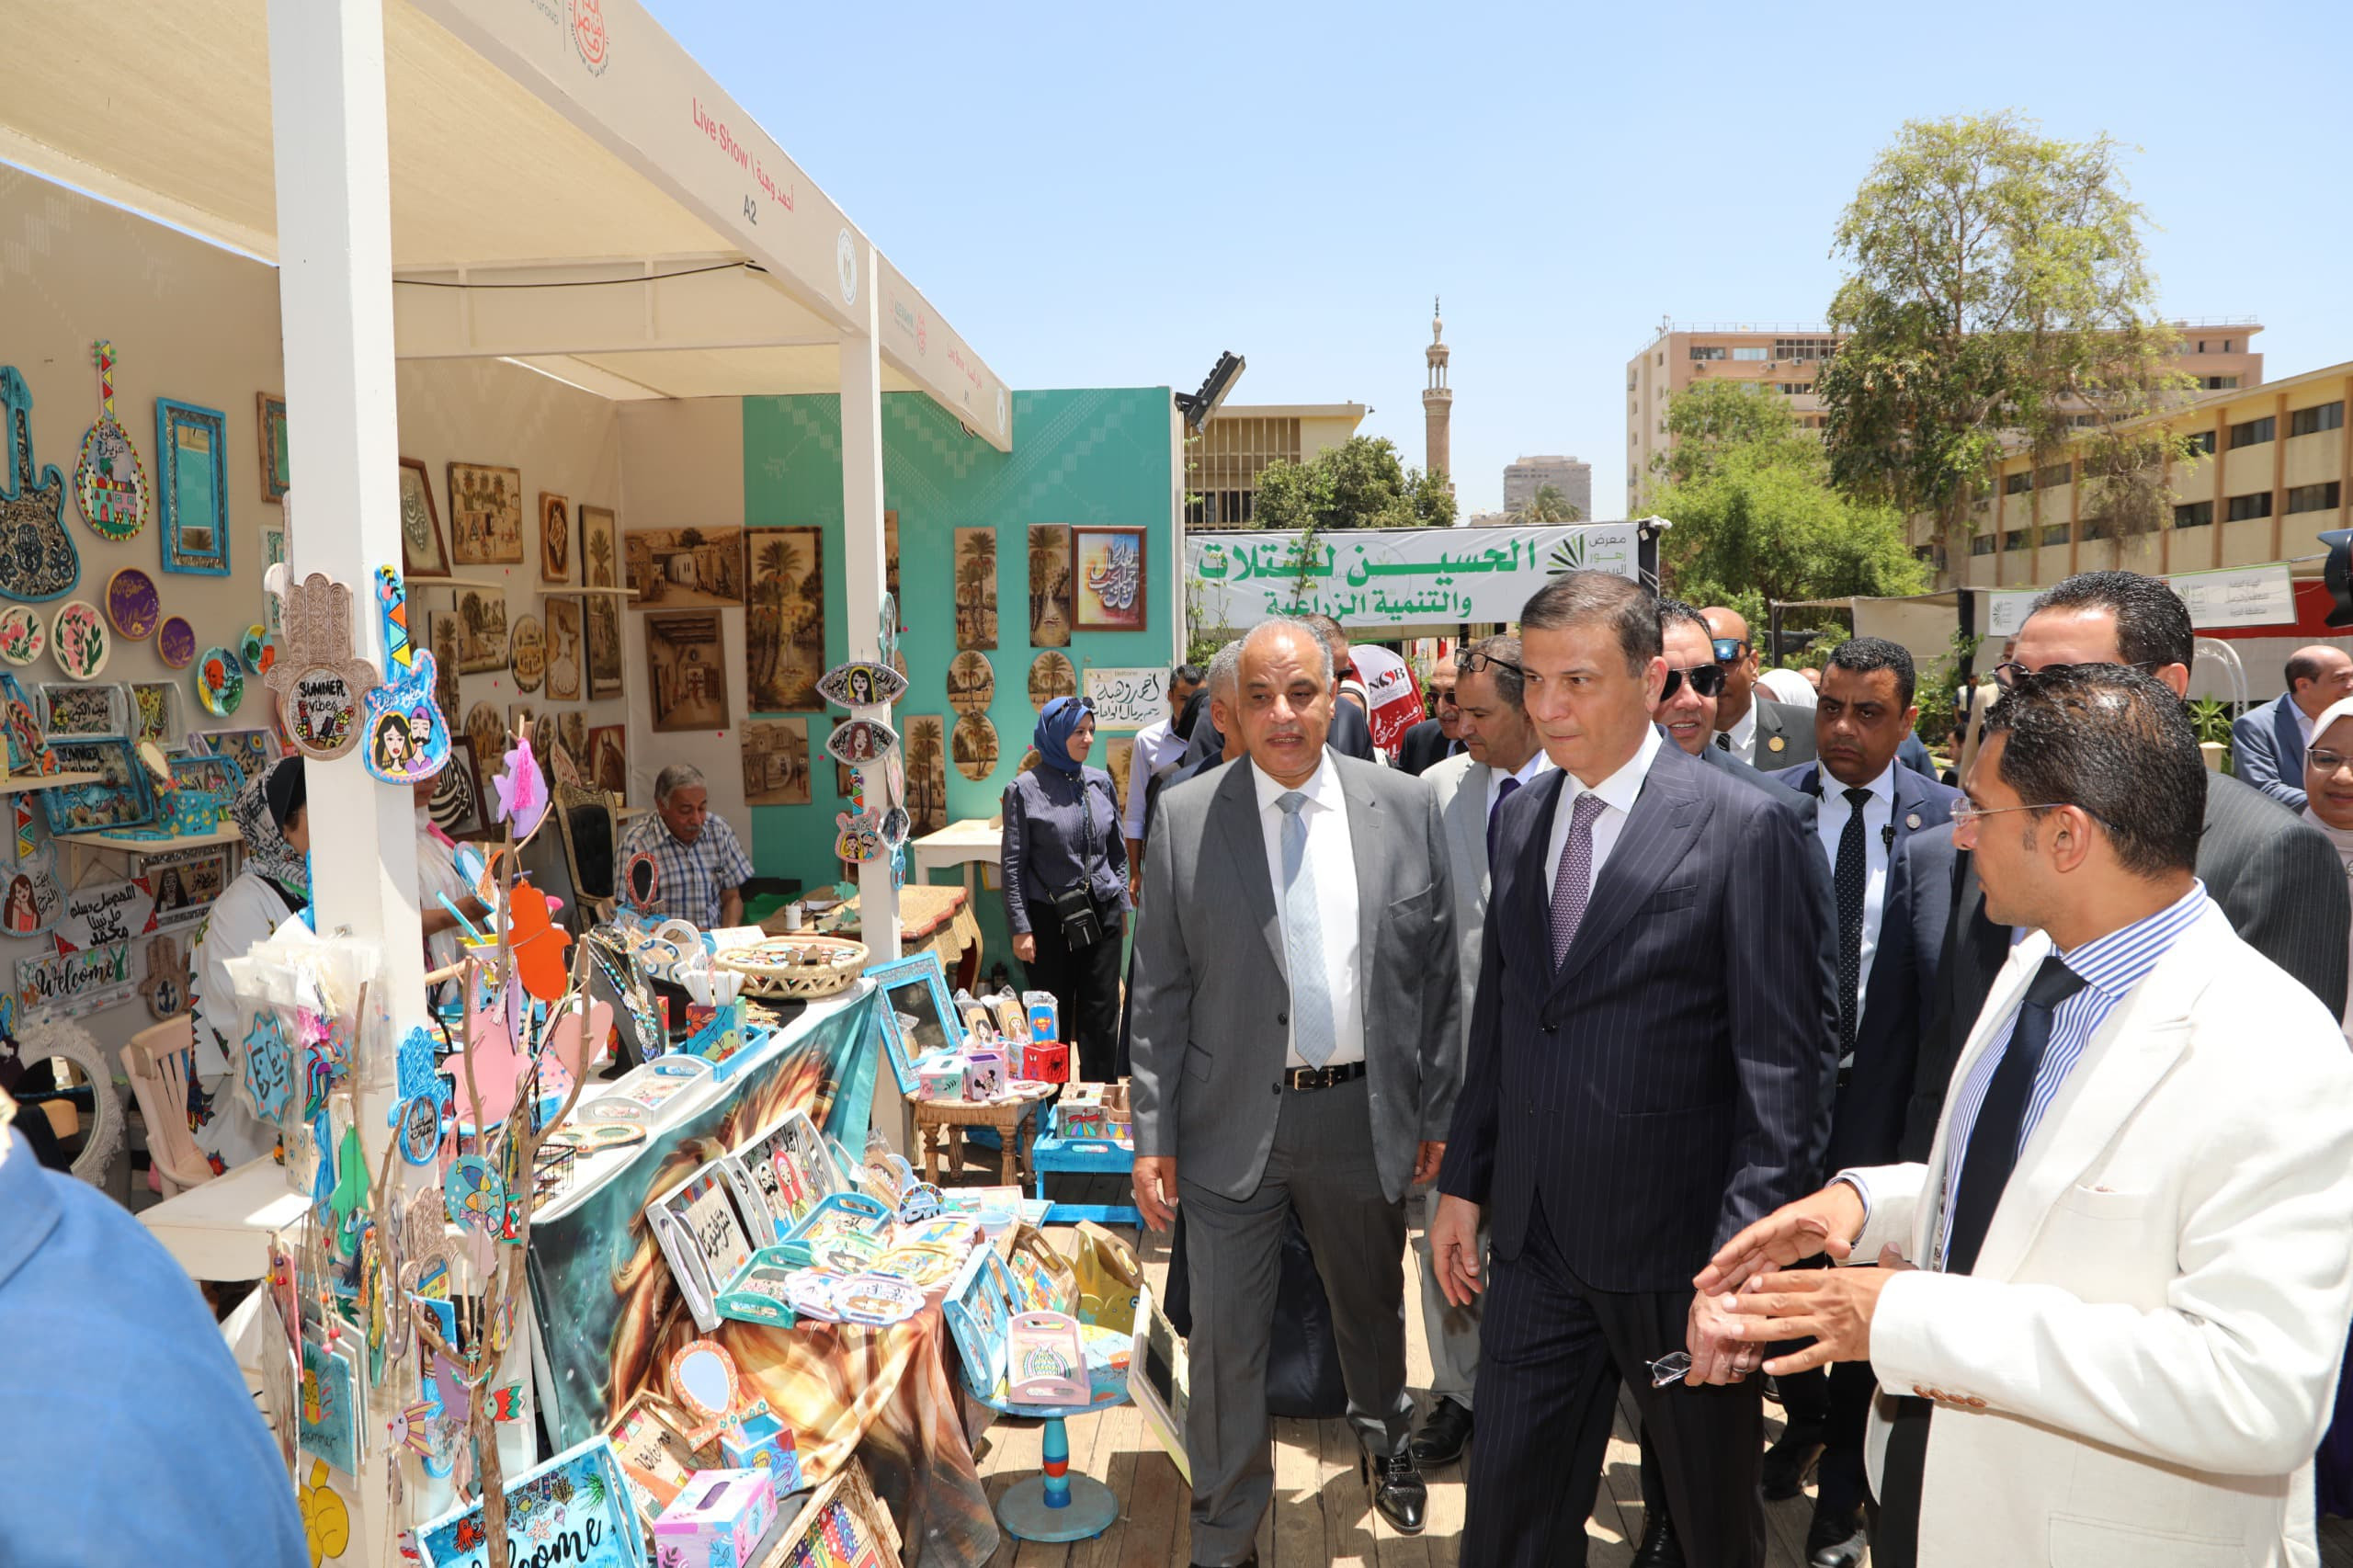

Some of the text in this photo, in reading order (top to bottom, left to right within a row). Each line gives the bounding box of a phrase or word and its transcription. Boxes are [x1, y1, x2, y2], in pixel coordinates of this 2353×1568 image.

[693, 97, 717, 142] Live
[719, 123, 748, 170] Show
[744, 194, 757, 226] A2
[1588, 533, 1627, 548] معرض
[1347, 538, 1536, 587] الحسين
[1374, 589, 1472, 621] والتنمية
[299, 679, 346, 698] SUMMER
[307, 699, 338, 712] vibes
[33, 871, 49, 889] بيت
[90, 926, 130, 946] محمد
[35, 960, 116, 997] Welcome
